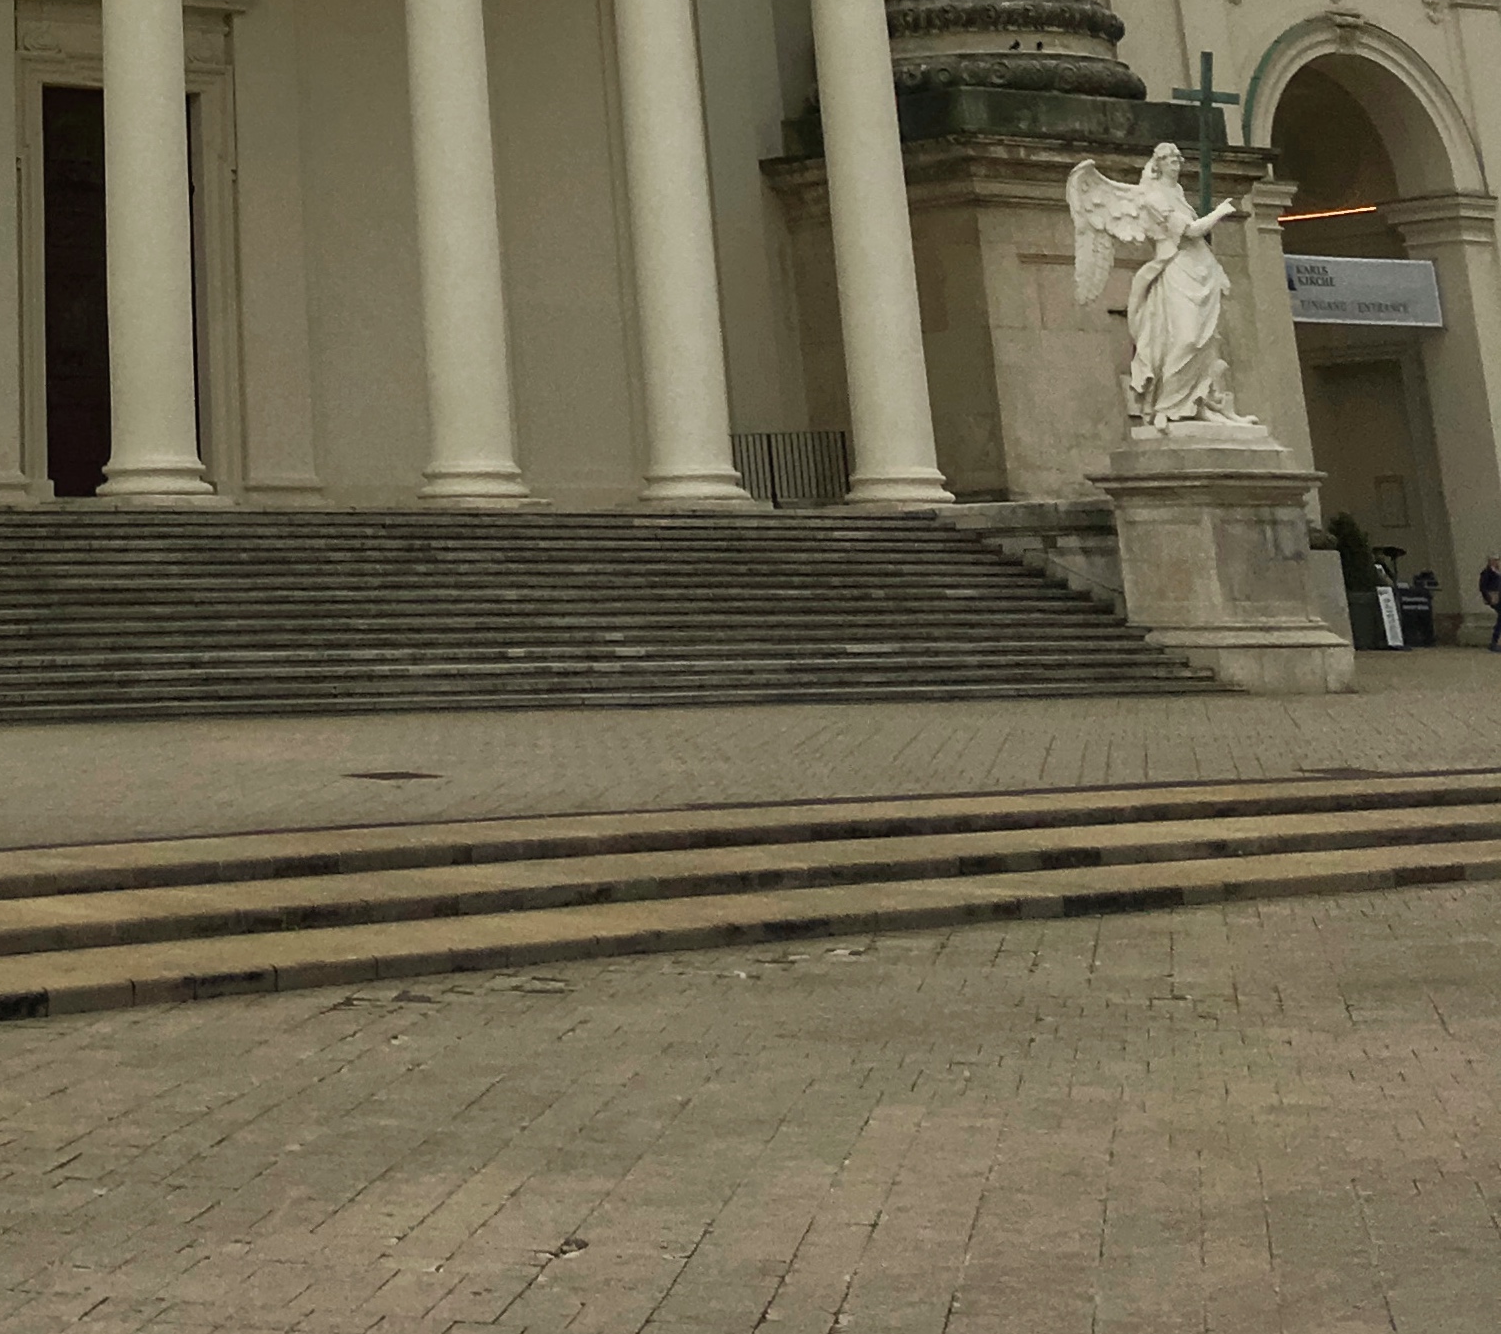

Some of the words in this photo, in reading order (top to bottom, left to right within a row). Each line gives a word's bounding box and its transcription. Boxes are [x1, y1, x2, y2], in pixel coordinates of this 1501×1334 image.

[1296, 264, 1329, 275] KARLS
[1297, 276, 1336, 287] KIRCHE
[1357, 301, 1410, 314] ENTRANCE
